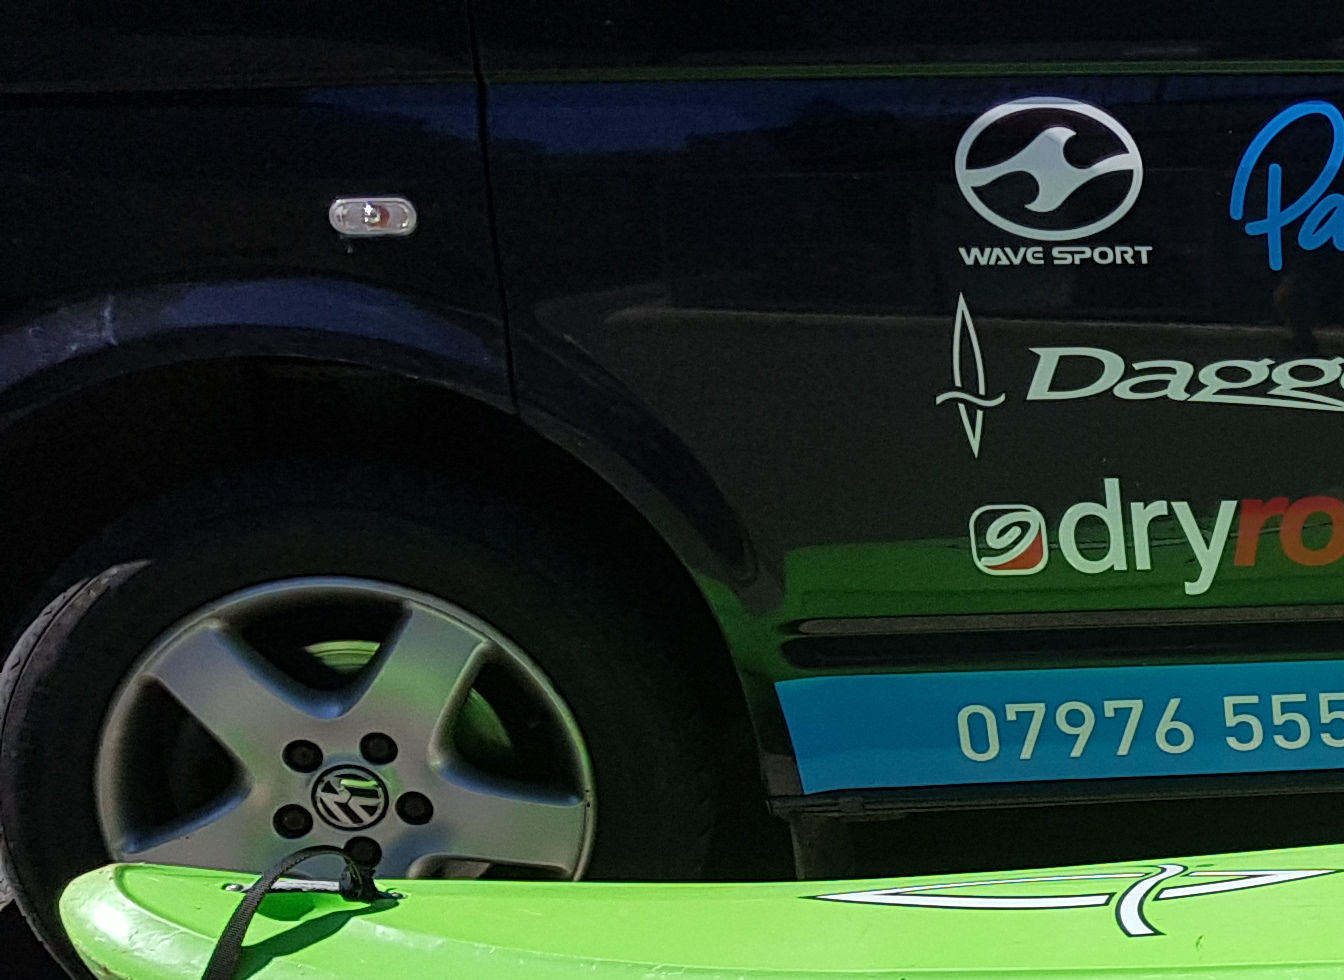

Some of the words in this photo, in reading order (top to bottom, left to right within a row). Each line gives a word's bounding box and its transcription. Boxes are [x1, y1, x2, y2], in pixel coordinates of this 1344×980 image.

[958, 246, 1045, 266] WAVE
[1051, 245, 1153, 265] SPORT
[956, 697, 1196, 762] 07976
